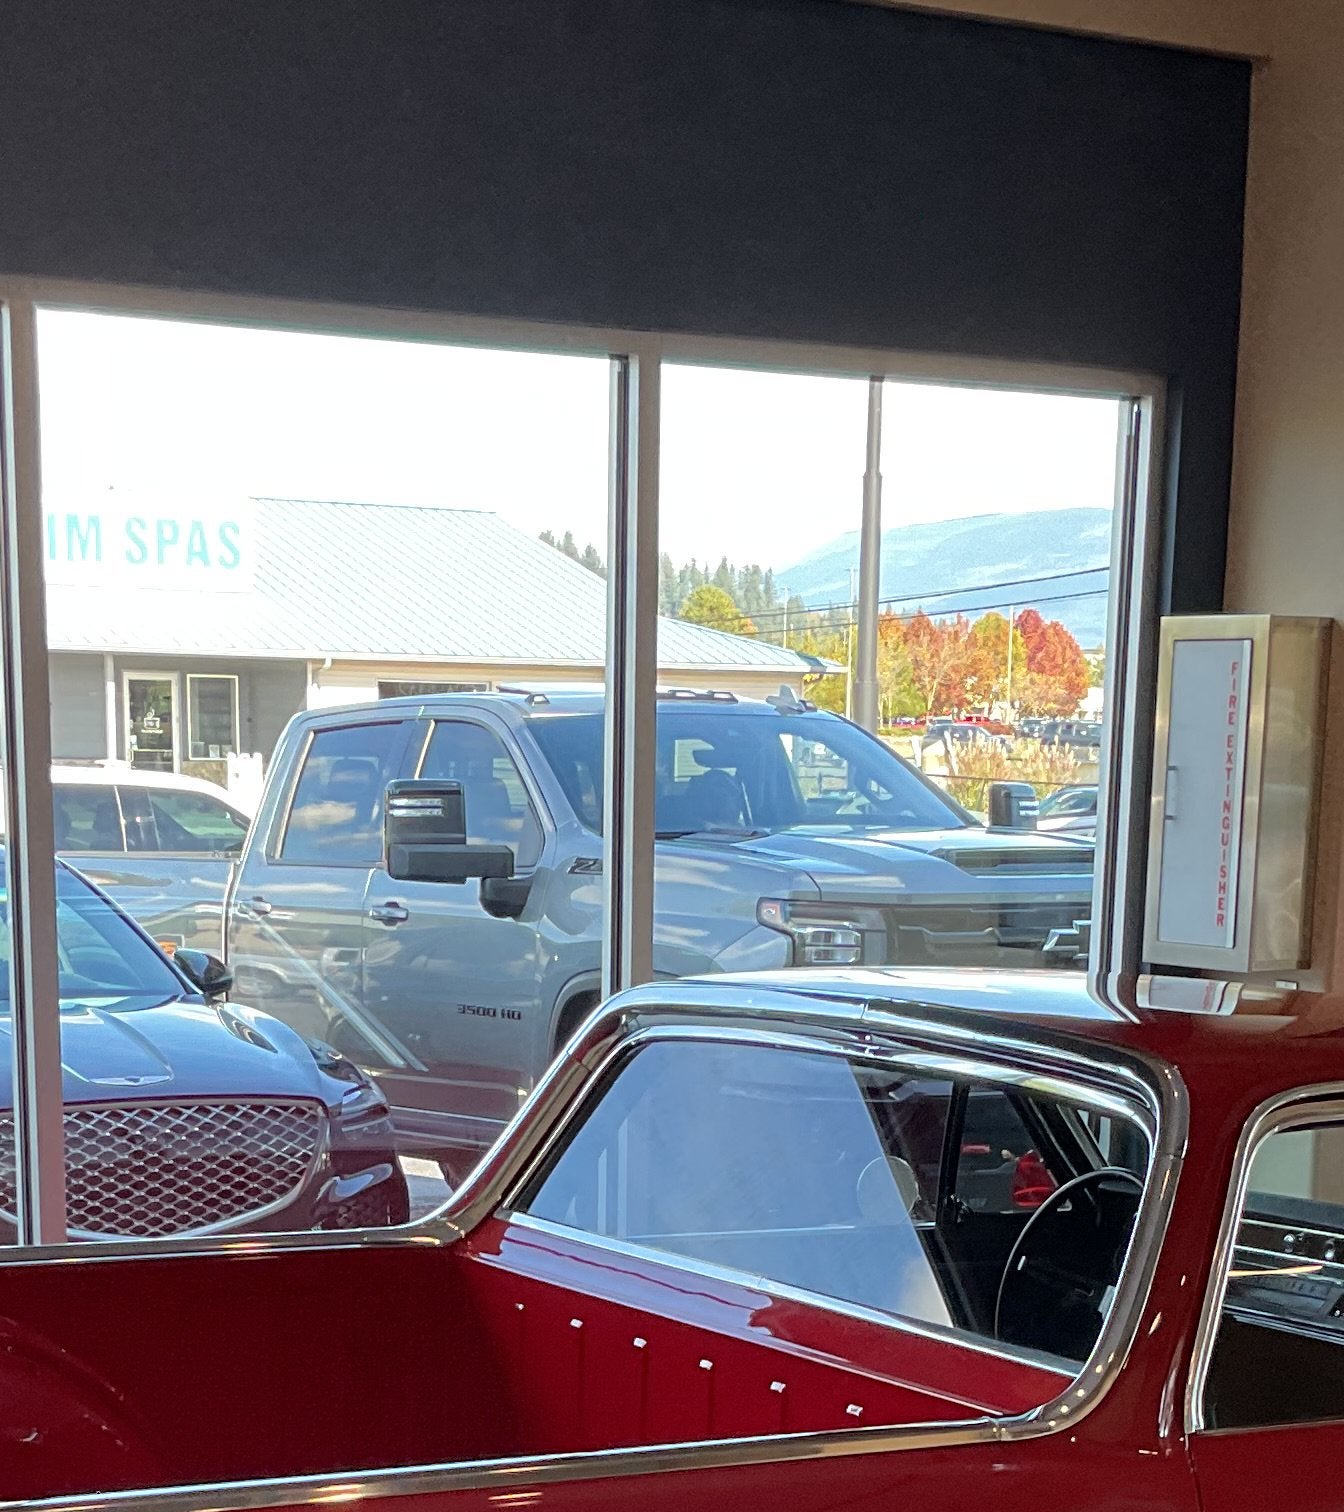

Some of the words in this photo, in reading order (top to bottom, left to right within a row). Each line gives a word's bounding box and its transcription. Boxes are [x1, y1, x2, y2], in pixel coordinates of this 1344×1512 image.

[124, 516, 241, 569] SPAS
[1227, 661, 1239, 725] FIRE
[1216, 734, 1235, 927] EXTINGUISHER
[456, 1003, 497, 1019] 3500
